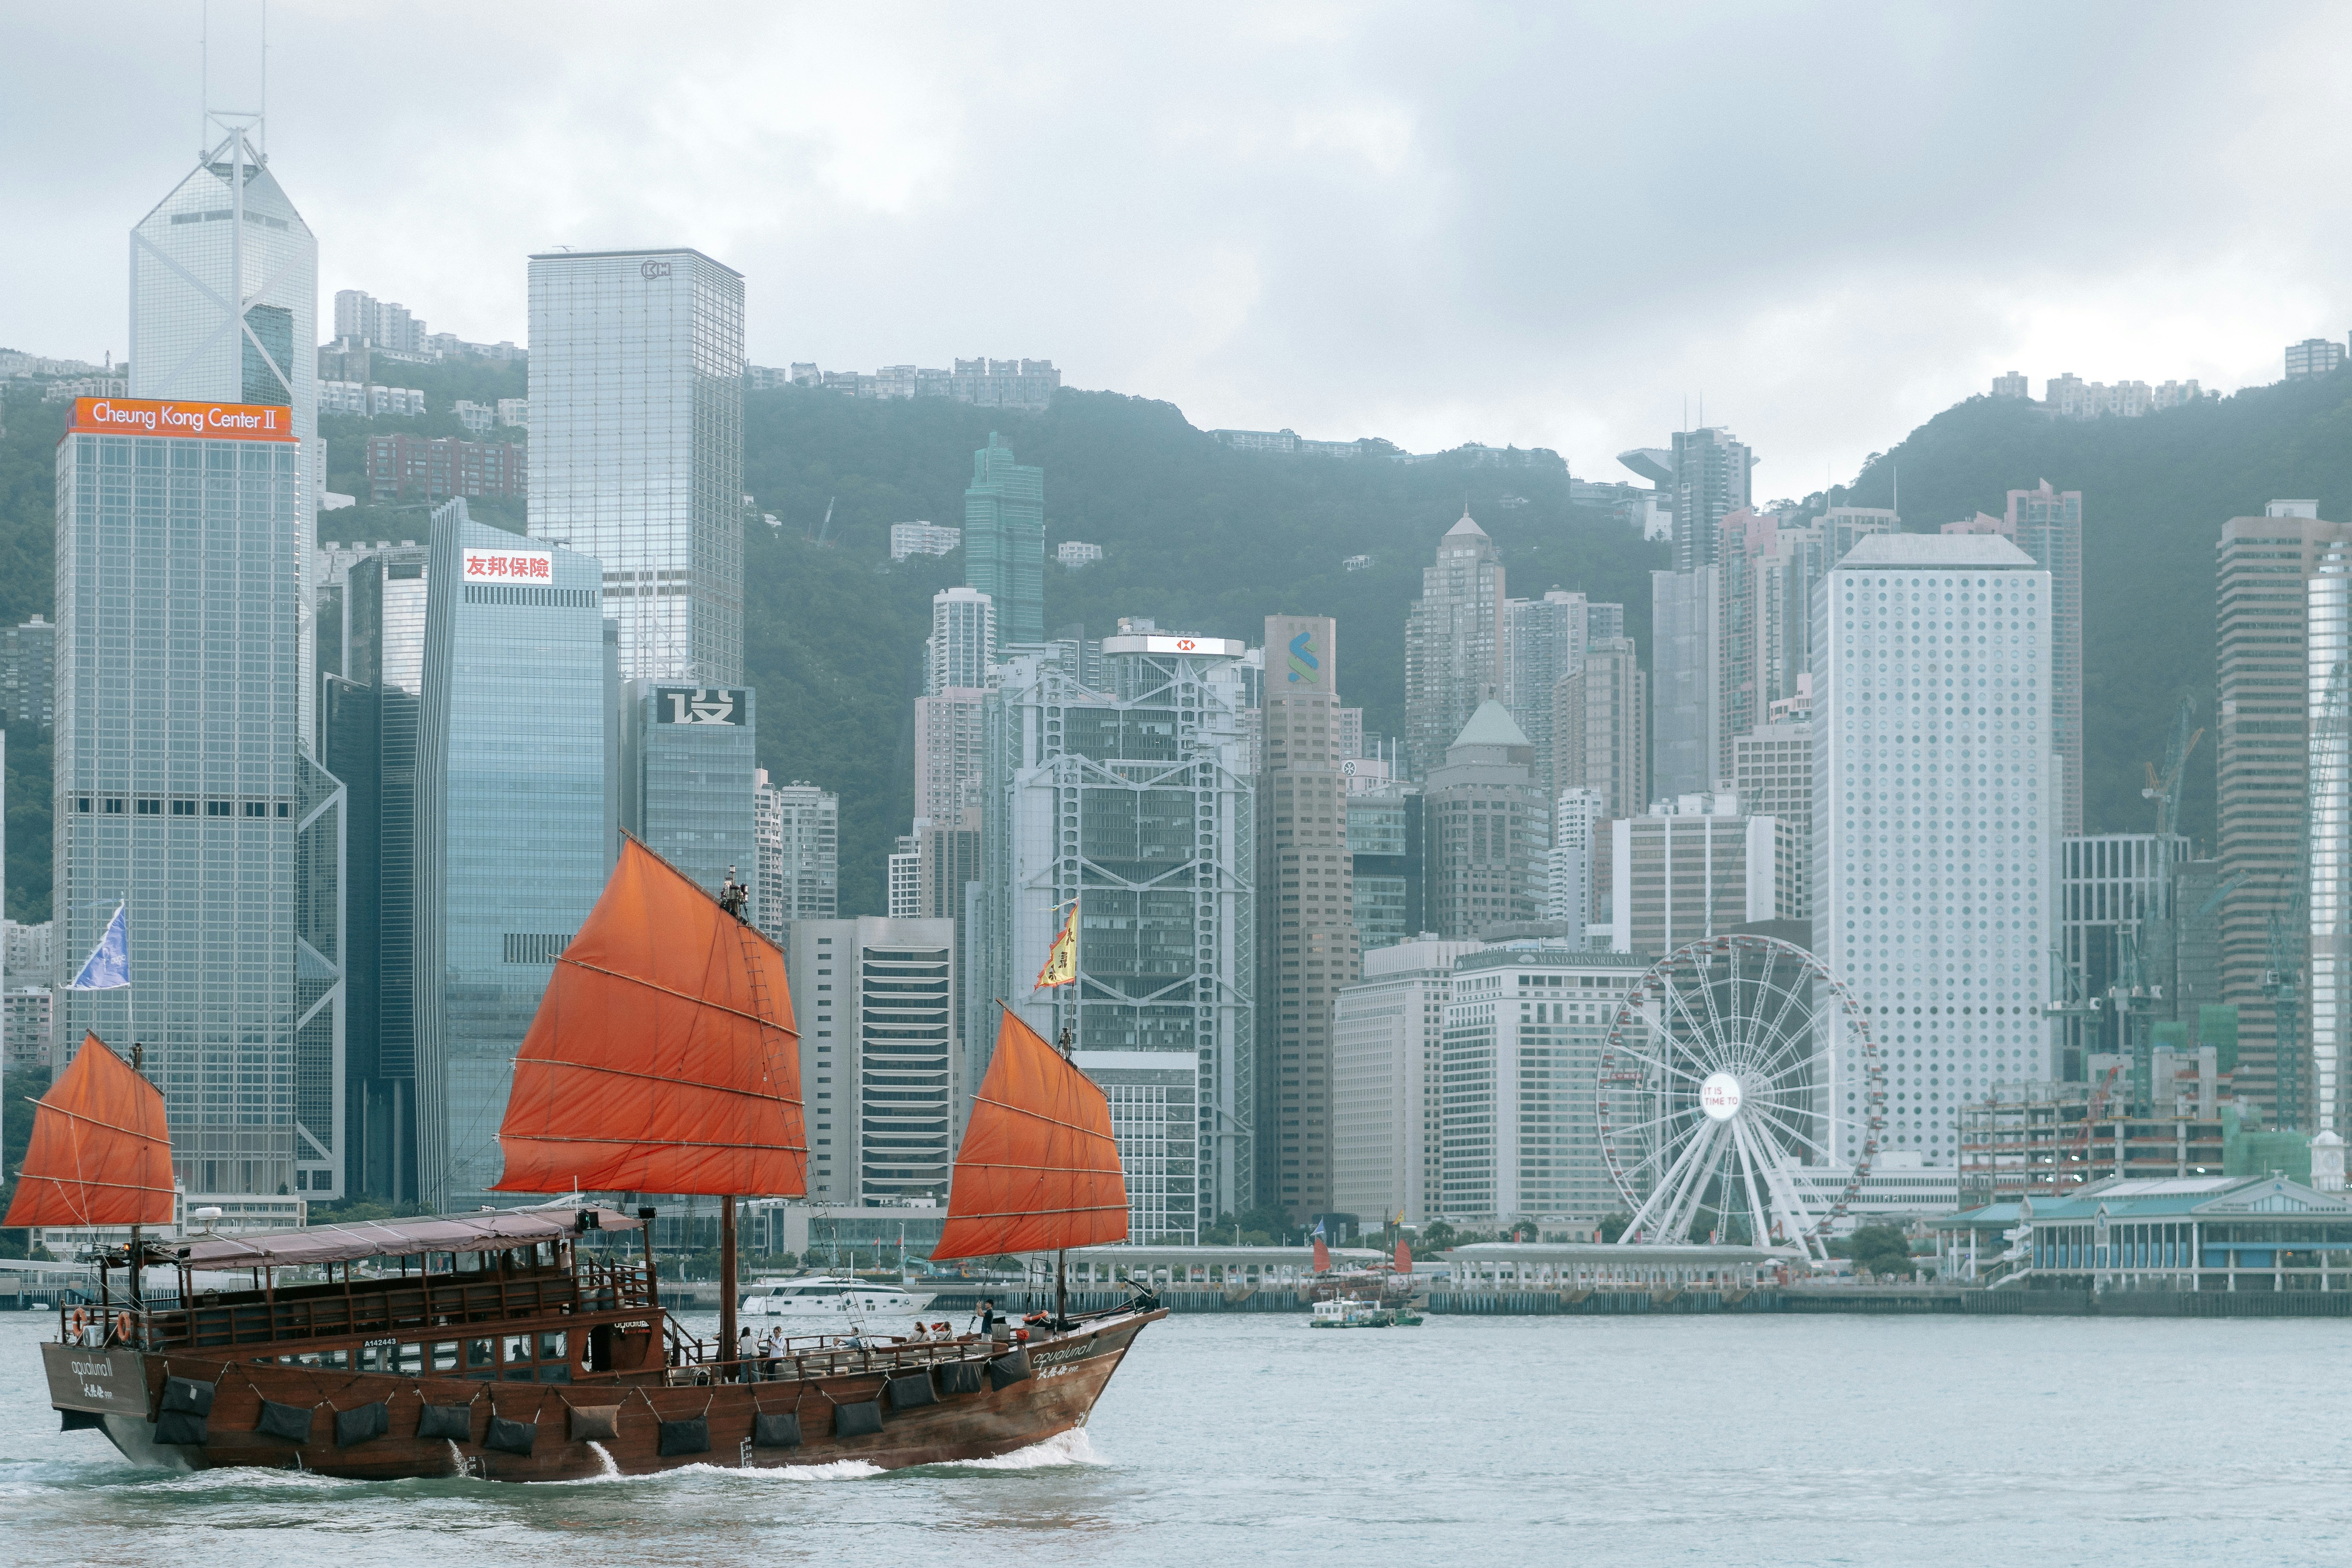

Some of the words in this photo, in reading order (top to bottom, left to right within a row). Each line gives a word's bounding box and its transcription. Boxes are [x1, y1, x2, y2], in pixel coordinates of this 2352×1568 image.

[93, 401, 156, 430] Cheung
[162, 406, 204, 432] Kong
[209, 408, 261, 428] Center
[263, 409, 277, 429] II
[467, 556, 549, 577] 友邦保險
[1538, 955, 1590, 964] MANDARIN
[1704, 1087, 1711, 1095] IT
[1705, 1097, 1724, 1105] TIME
[364, 1338, 396, 1347] A142443
